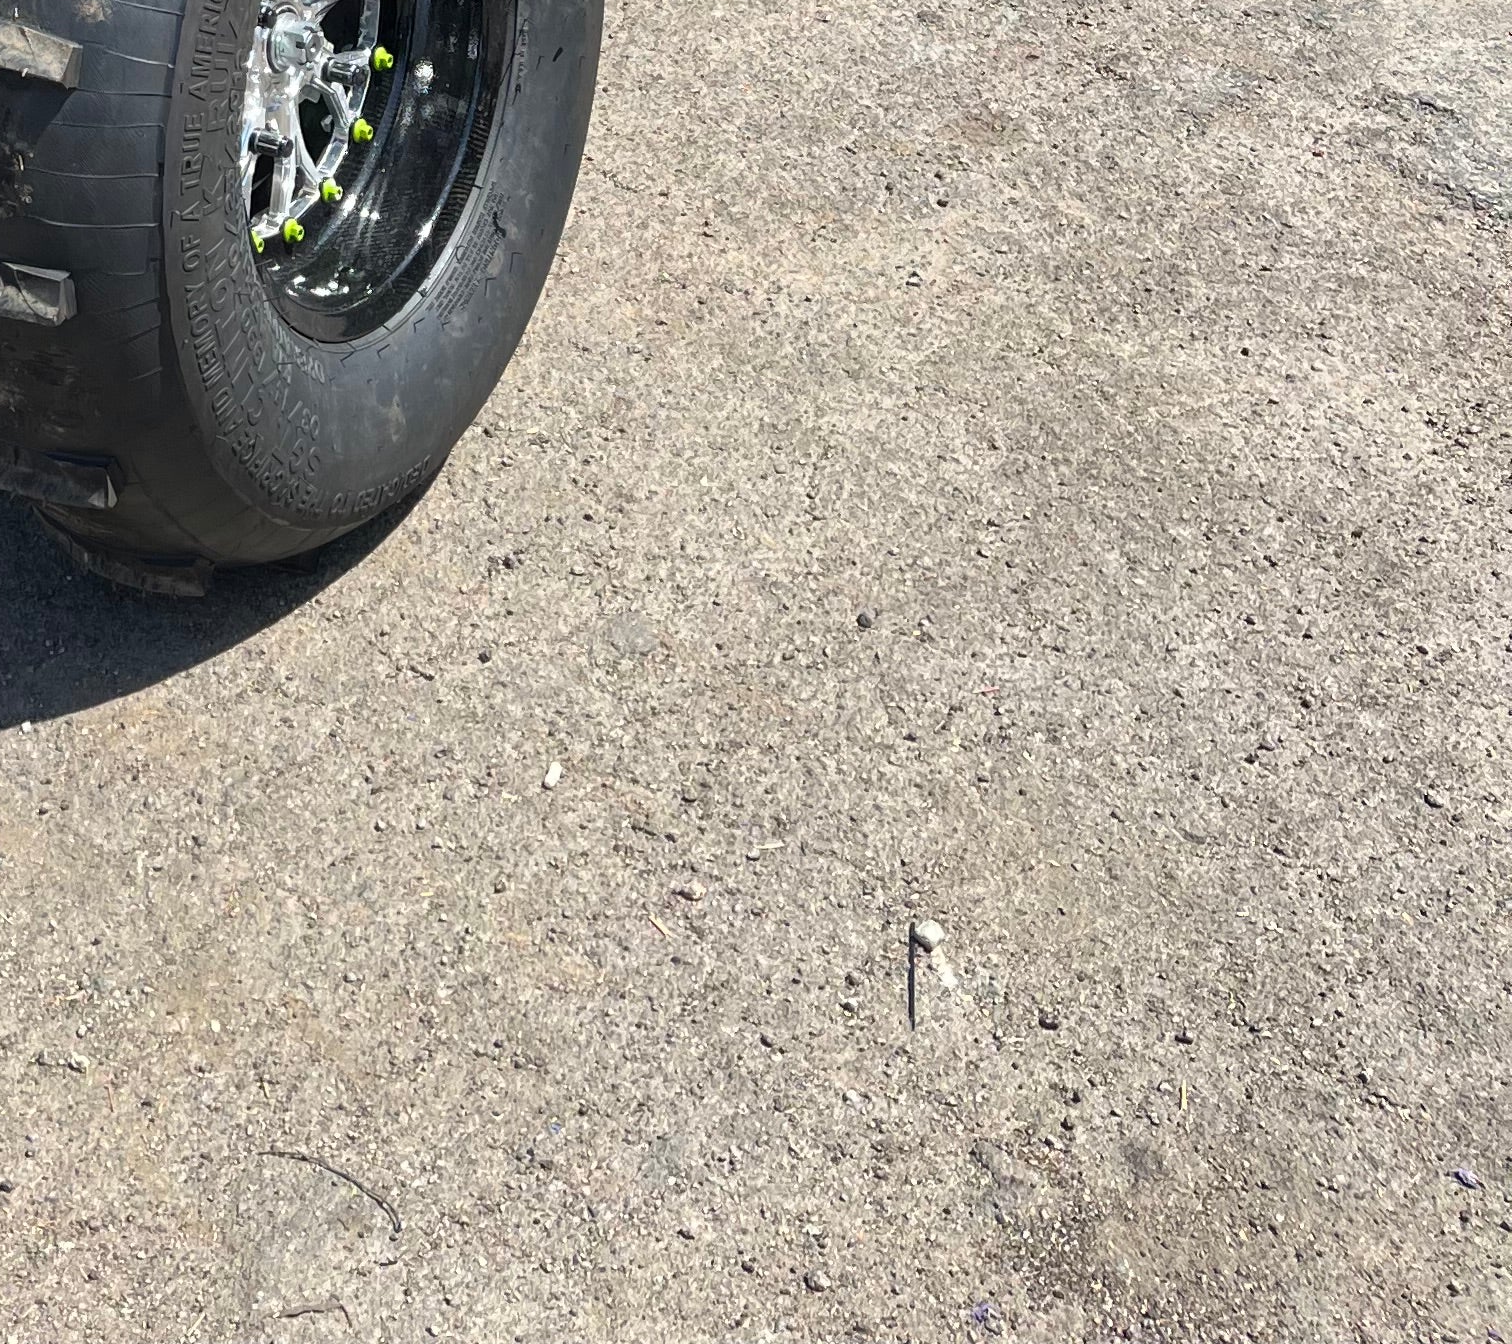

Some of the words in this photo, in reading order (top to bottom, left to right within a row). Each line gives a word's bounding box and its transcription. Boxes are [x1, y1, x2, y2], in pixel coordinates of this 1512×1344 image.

[179, 107, 204, 199] TRUE
[180, 219, 201, 282] OF
[183, 265, 223, 404] MEMORY
[209, 375, 243, 451] AND
